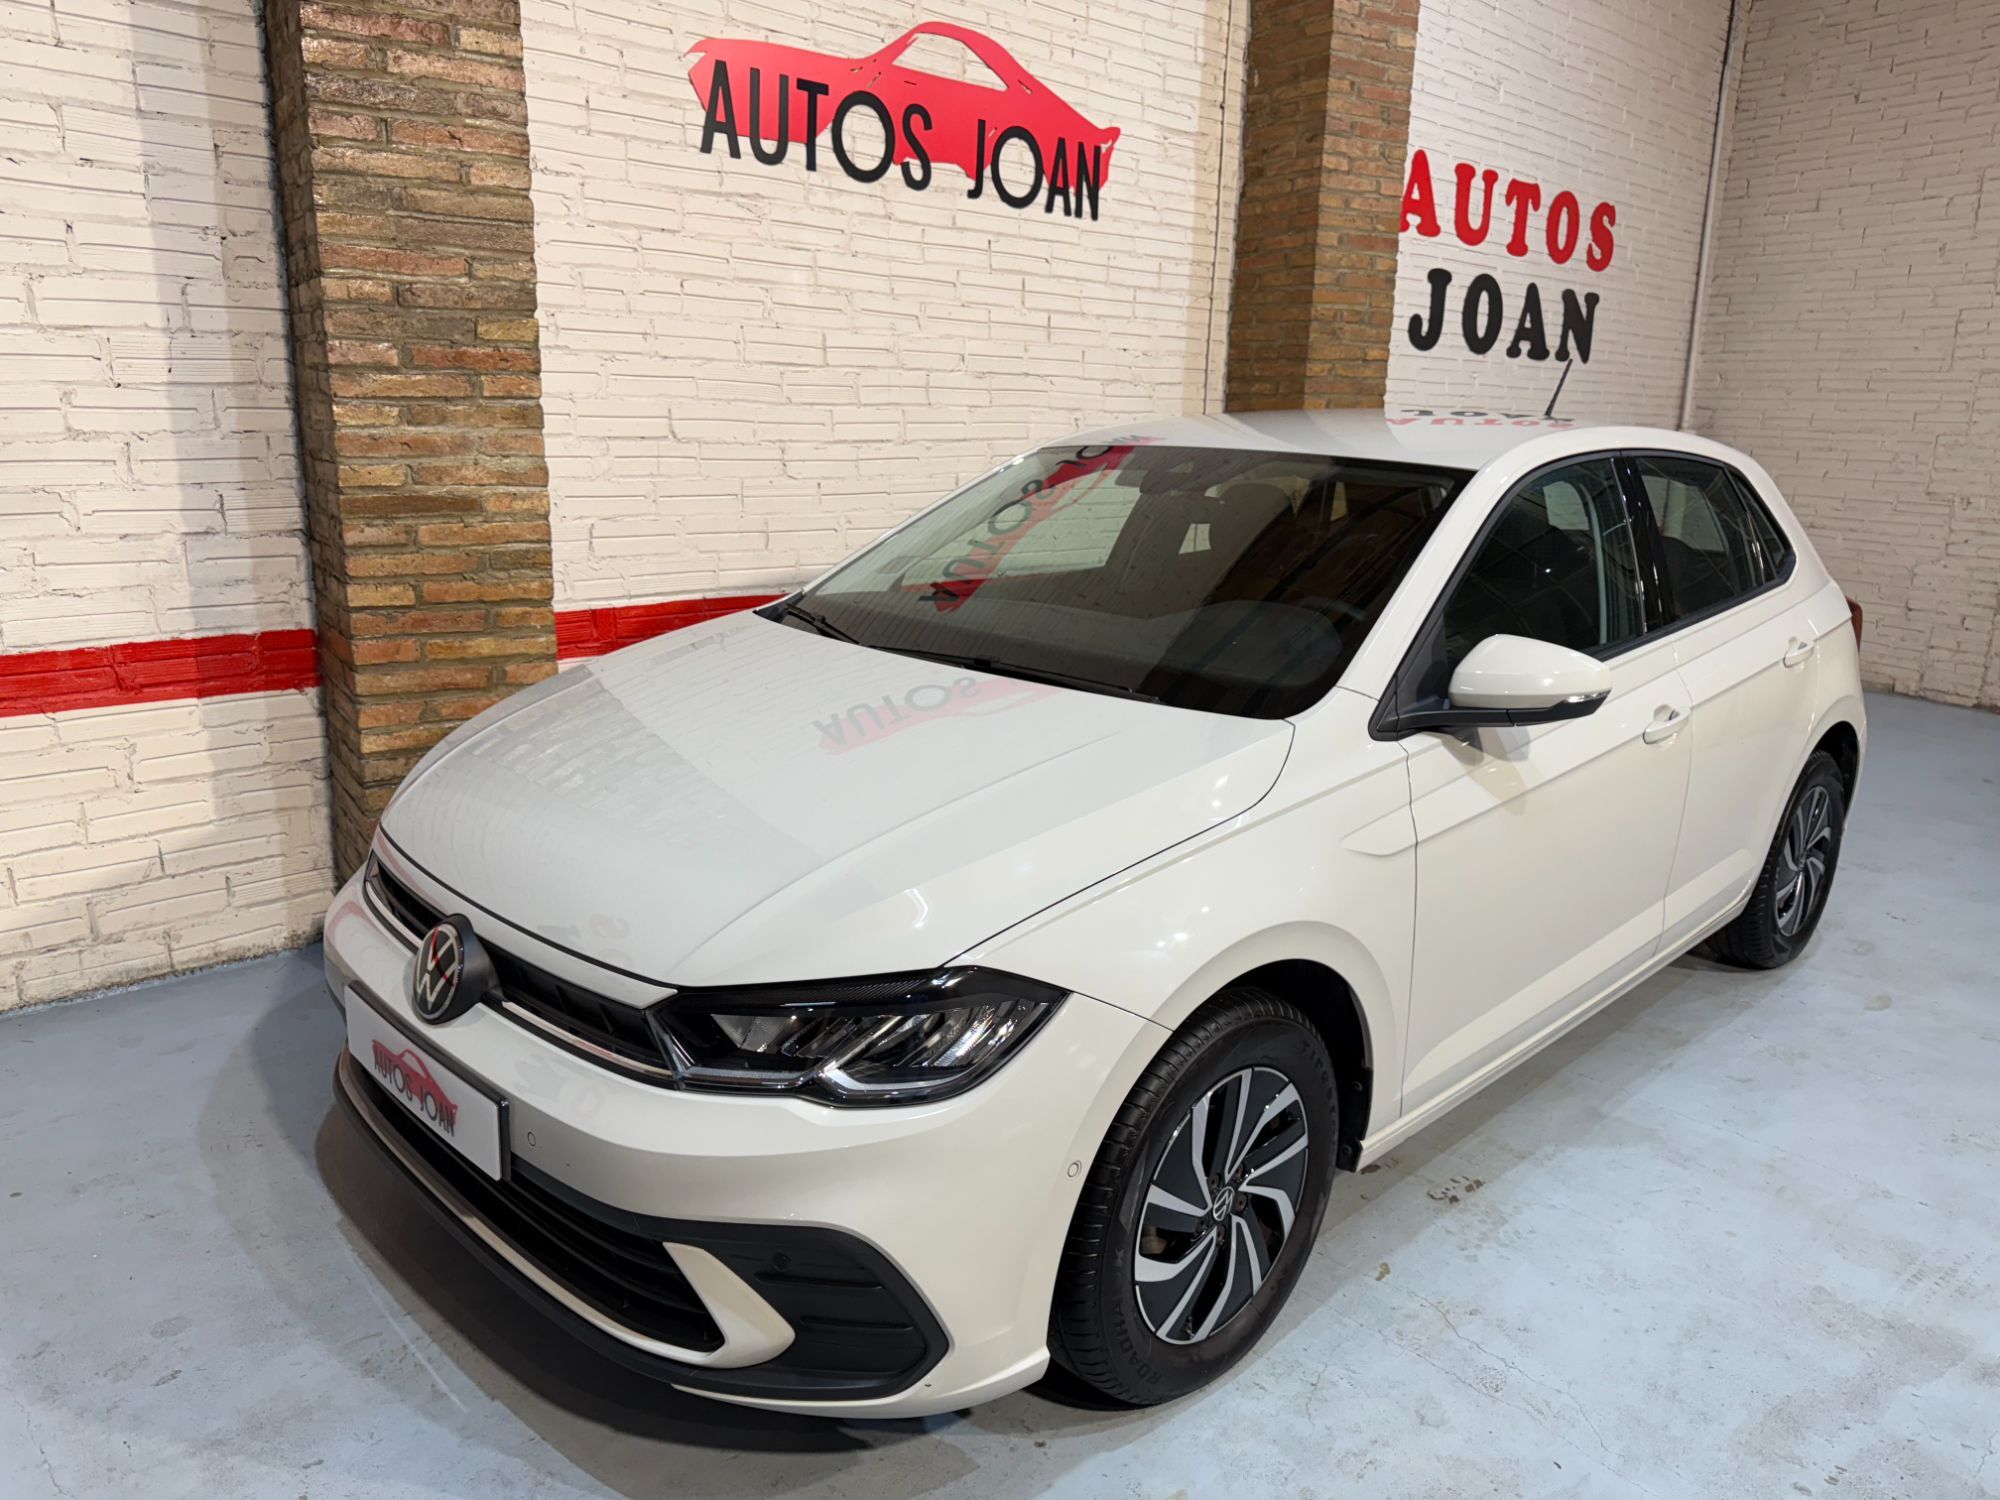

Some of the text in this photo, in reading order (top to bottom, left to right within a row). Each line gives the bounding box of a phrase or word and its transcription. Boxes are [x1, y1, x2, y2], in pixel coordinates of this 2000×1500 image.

[700, 59, 1101, 221] AUTOS JOAN
[1399, 149, 1616, 272] AUTOS
[1408, 268, 1600, 364] JOAN
[374, 1047, 455, 1137] AUTOS JOAN
